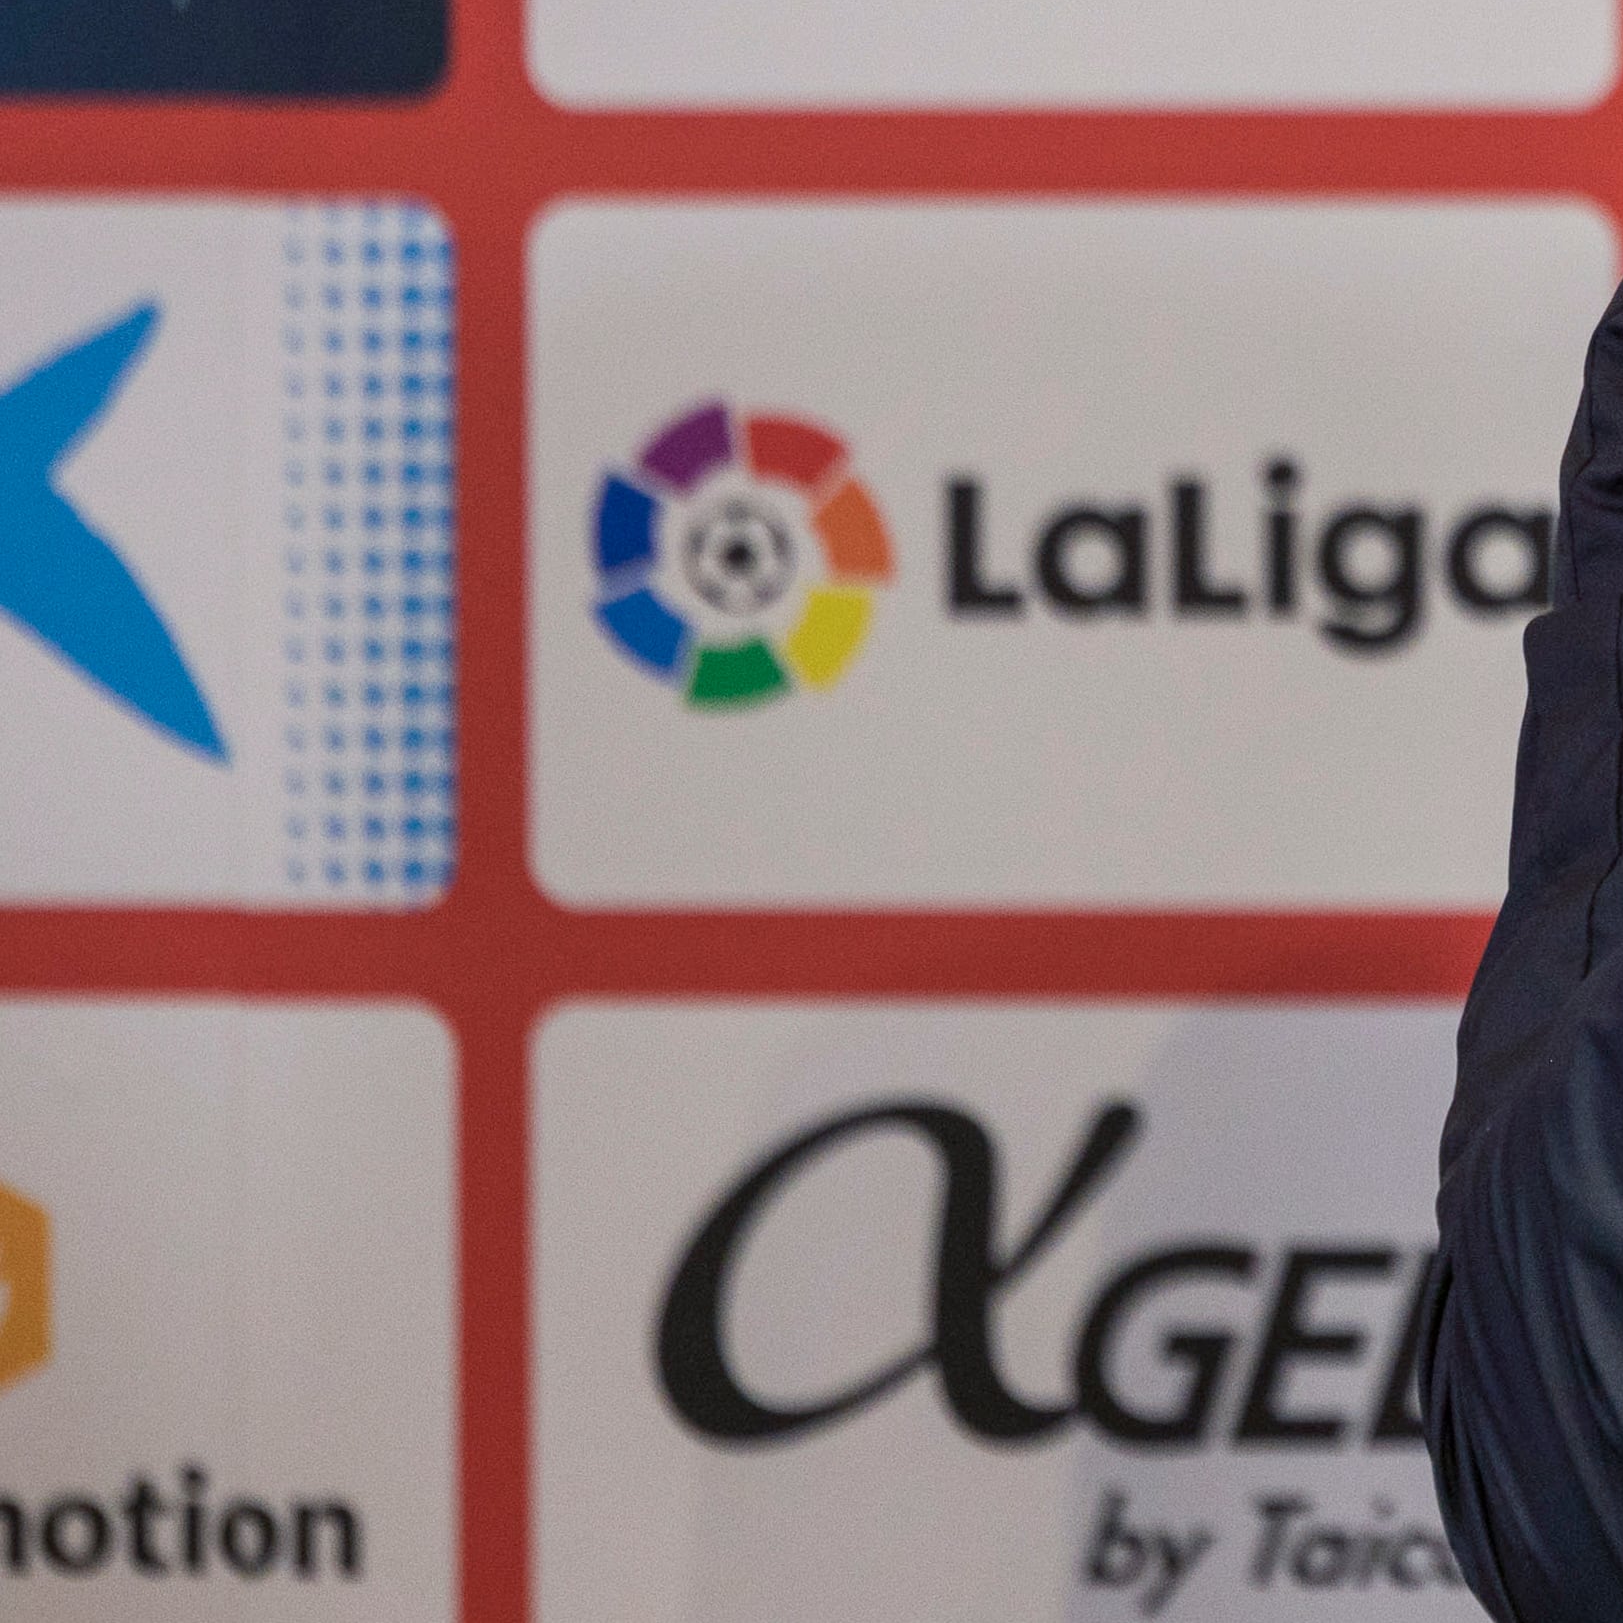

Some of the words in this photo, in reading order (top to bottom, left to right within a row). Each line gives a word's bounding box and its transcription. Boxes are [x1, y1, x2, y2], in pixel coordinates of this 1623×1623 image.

[946, 458, 1557, 658] LaLiga
[0, 1462, 362, 1582] otion
[1085, 1486, 1212, 1618] by
